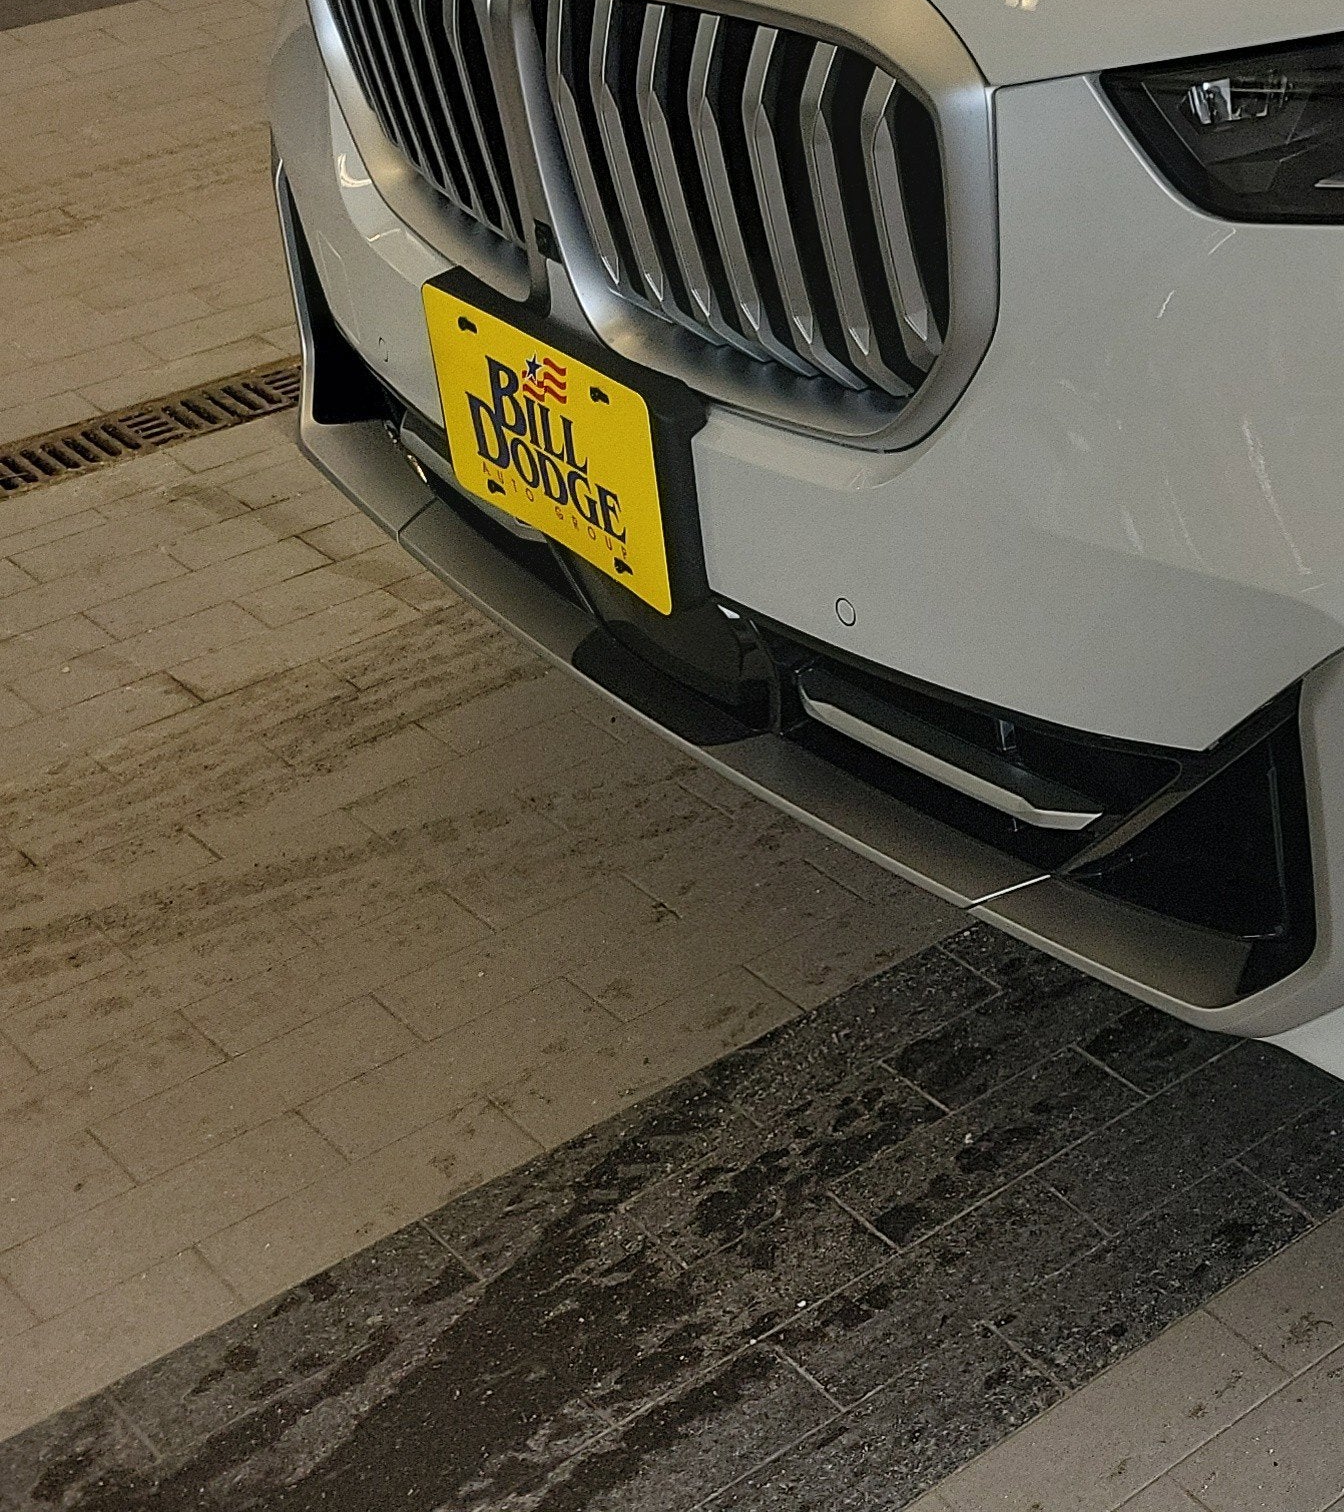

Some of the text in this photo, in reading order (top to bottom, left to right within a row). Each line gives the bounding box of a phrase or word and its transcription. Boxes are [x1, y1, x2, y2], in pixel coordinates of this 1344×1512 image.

[465, 391, 627, 544] DODGE
[486, 355, 588, 476] BILL
[482, 461, 627, 560] AUTO GROUP
